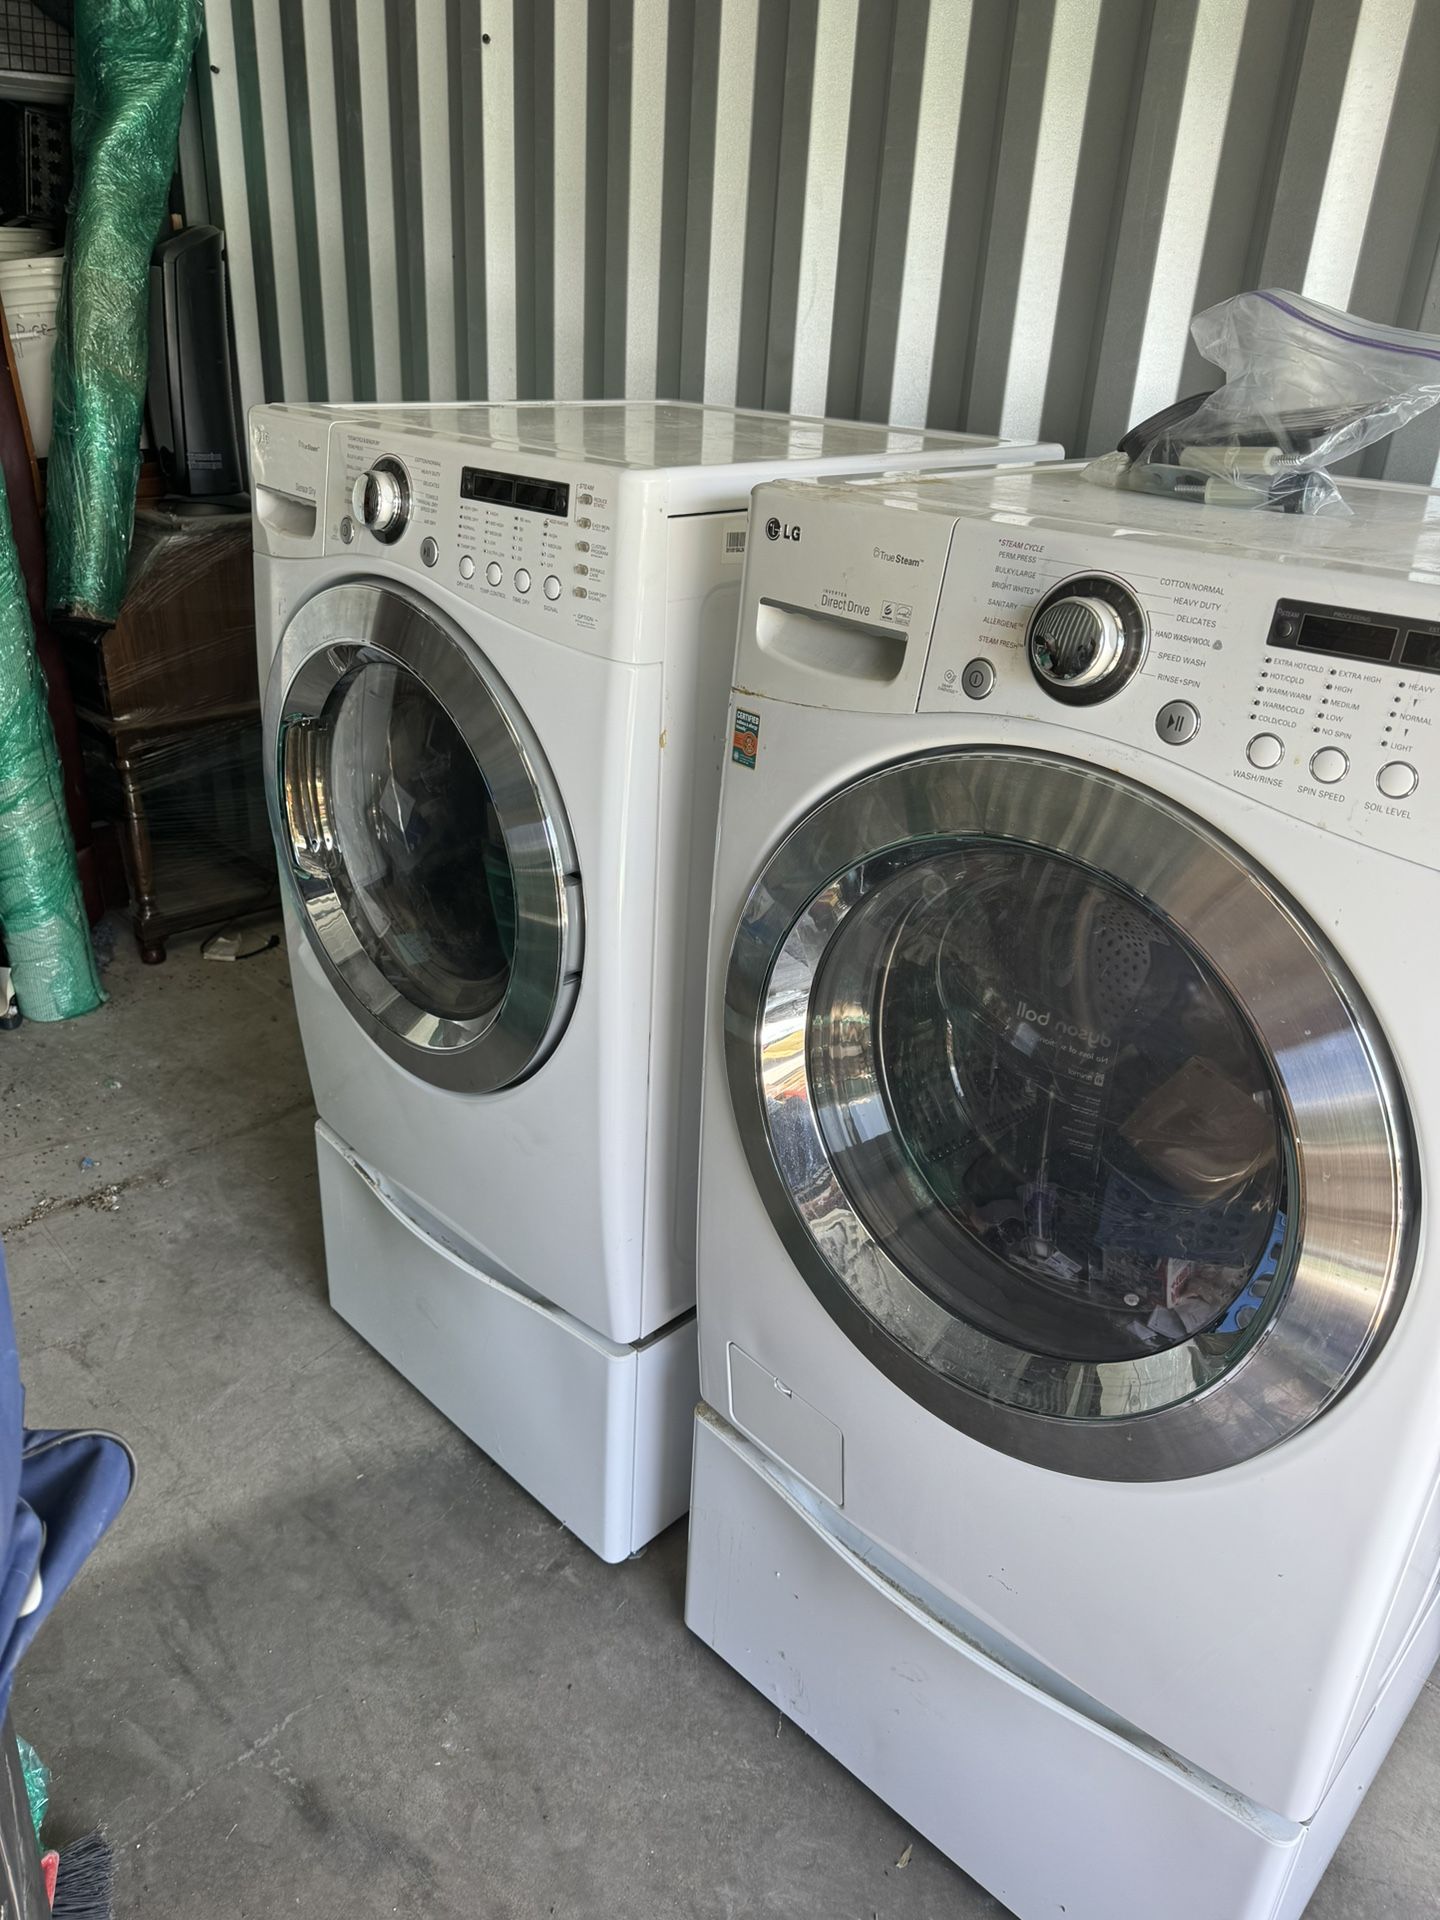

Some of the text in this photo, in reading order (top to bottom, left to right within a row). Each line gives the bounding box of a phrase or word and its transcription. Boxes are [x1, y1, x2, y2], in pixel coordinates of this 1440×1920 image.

[784, 524, 801, 541] LG
[1024, 543, 1045, 553] CYCLE
[995, 565, 1037, 579] BULKY/LARGE
[823, 588, 847, 597] INVERTER
[991, 581, 1012, 592] BRIGHT
[1160, 578, 1225, 595] COTTON/NORMAL
[987, 598, 1018, 610] SANITARY
[1173, 597, 1222, 611] HEAVY DUTY
[1176, 614, 1217, 628] DELICATES
[1333, 611, 1372, 623] PROCESSING
[978, 635, 999, 645] STEAM
[1155, 630, 1210, 647] HAND WASH/WOOL
[1157, 652, 1207, 667] SPEED WASH
[1273, 658, 1324, 673] EXTRA HOT/COLD
[1157, 673, 1201, 688] RINSE+SPIN
[1269, 673, 1305, 685] HOT/COLD
[1338, 670, 1382, 684] EXTRA HIGH
[1266, 687, 1312, 701] WARM/WARM
[1334, 685, 1353, 694] HIGH
[1408, 683, 1435, 693] HEAVY
[1262, 701, 1305, 715] WARM/COLD
[1330, 699, 1360, 710] MEDIUM
[1258, 714, 1297, 728] COLD/COLD
[1326, 714, 1344, 722] LOW
[1399, 713, 1432, 726] NORMAL
[1334, 731, 1352, 740] SPIN
[1390, 742, 1414, 753] LIGHT
[1232, 769, 1284, 788] WASH/RINSE
[1297, 785, 1345, 803] SPIN SPEED
[1364, 801, 1412, 820] SOIL LEVEL
